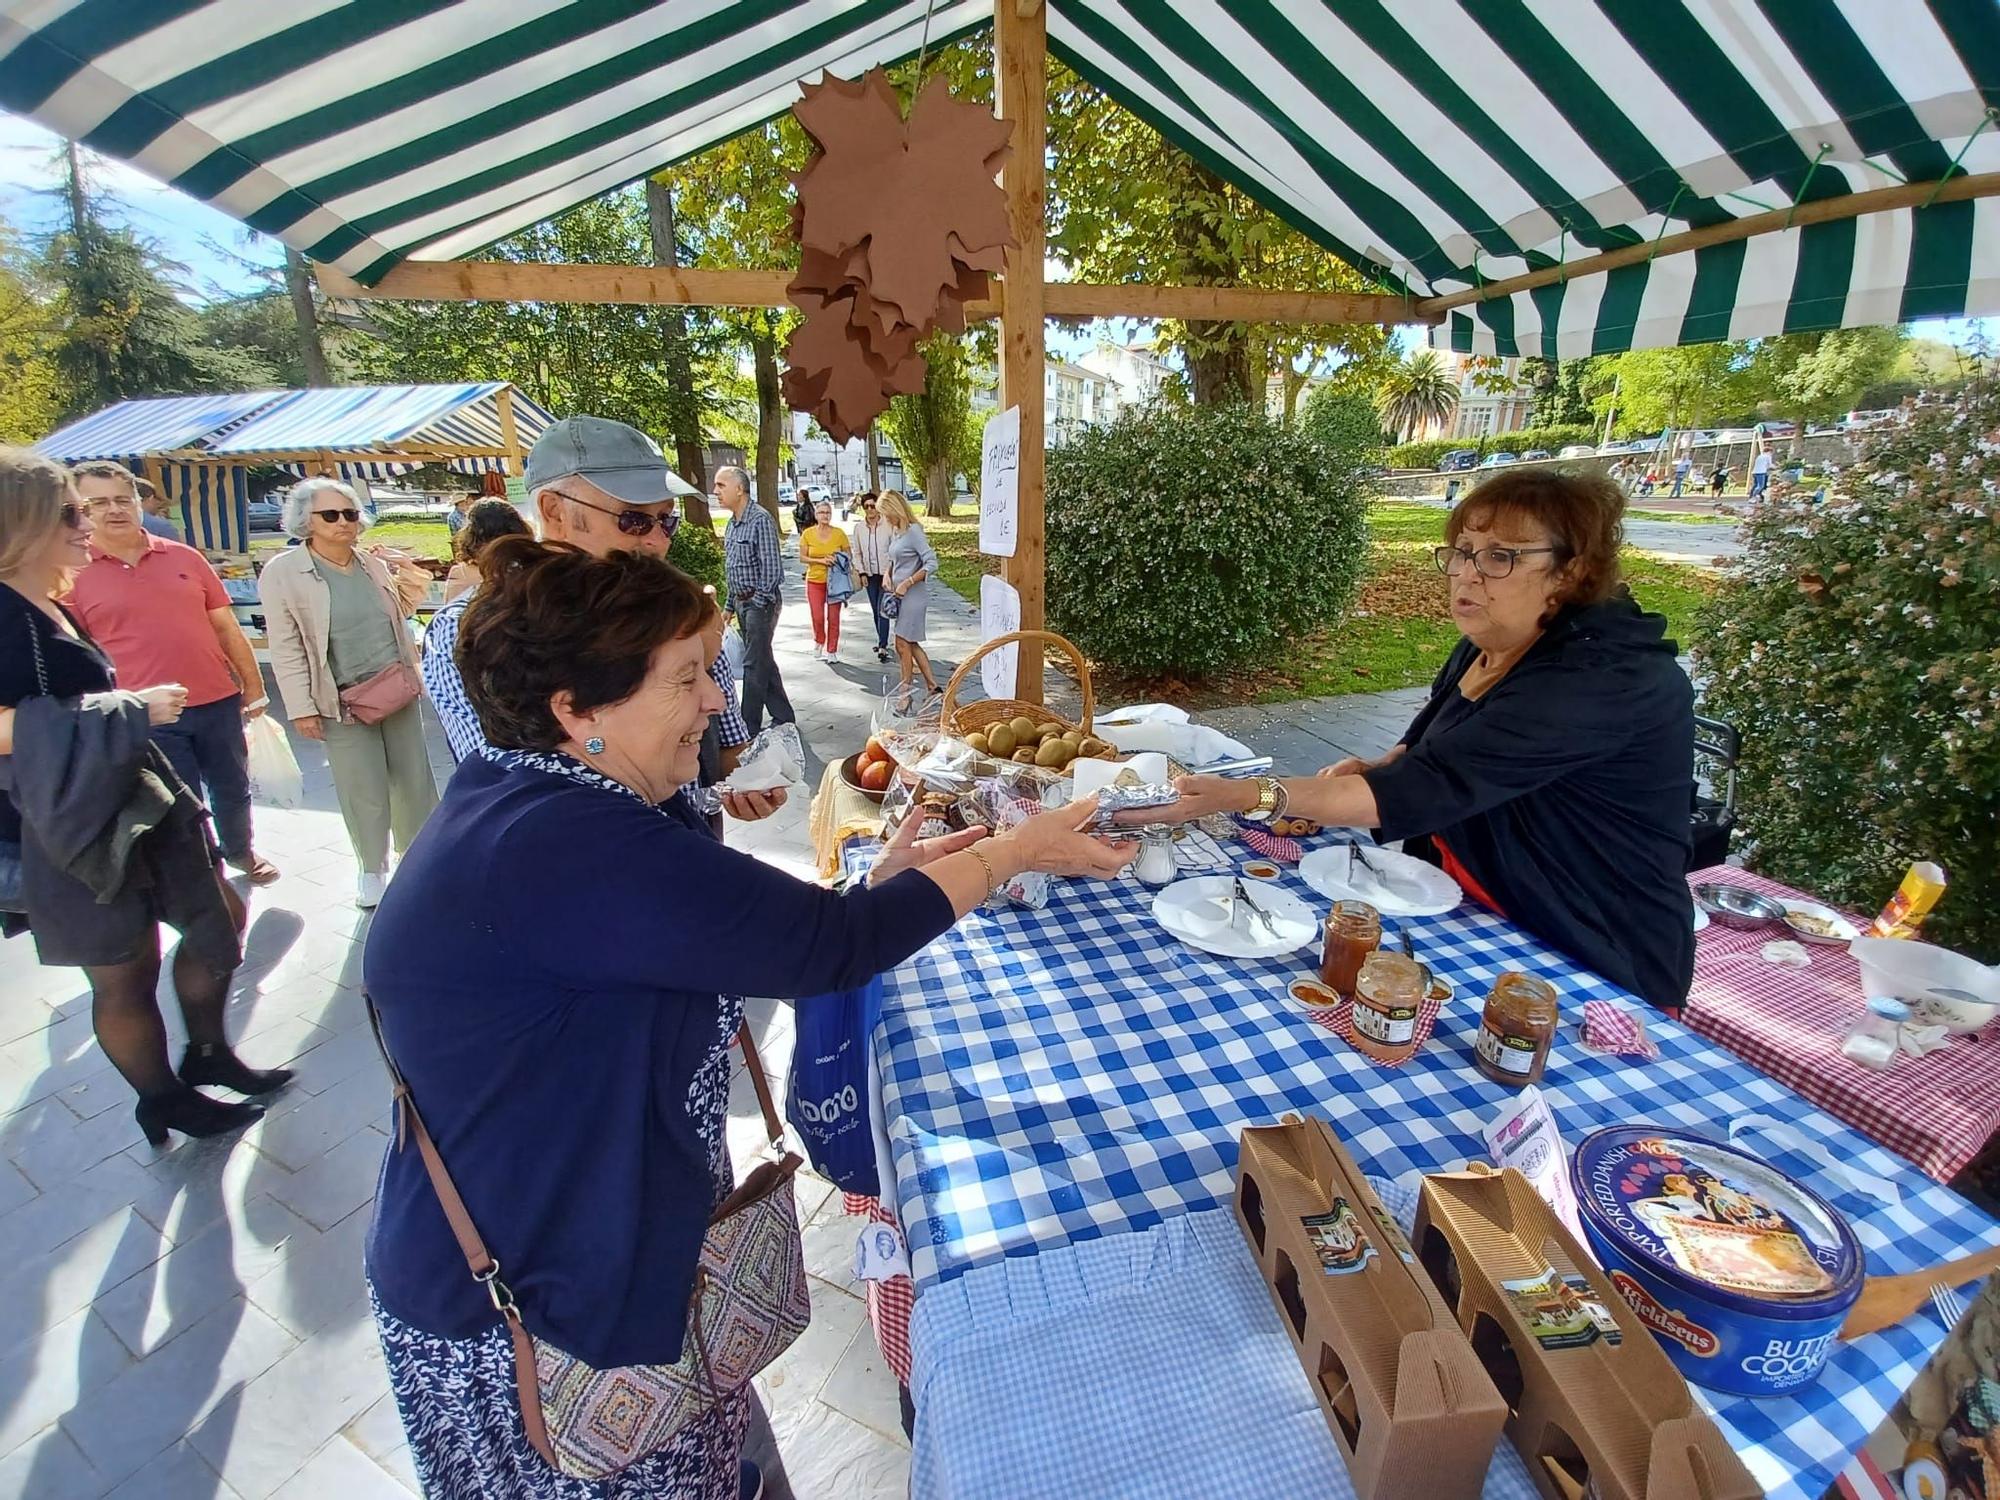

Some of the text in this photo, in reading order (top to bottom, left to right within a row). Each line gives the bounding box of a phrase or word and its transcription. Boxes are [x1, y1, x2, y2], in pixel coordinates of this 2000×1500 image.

[1592, 1146, 1669, 1258] IMPORTED DANISH
[1620, 1281, 1710, 1348] Kjeldsens
